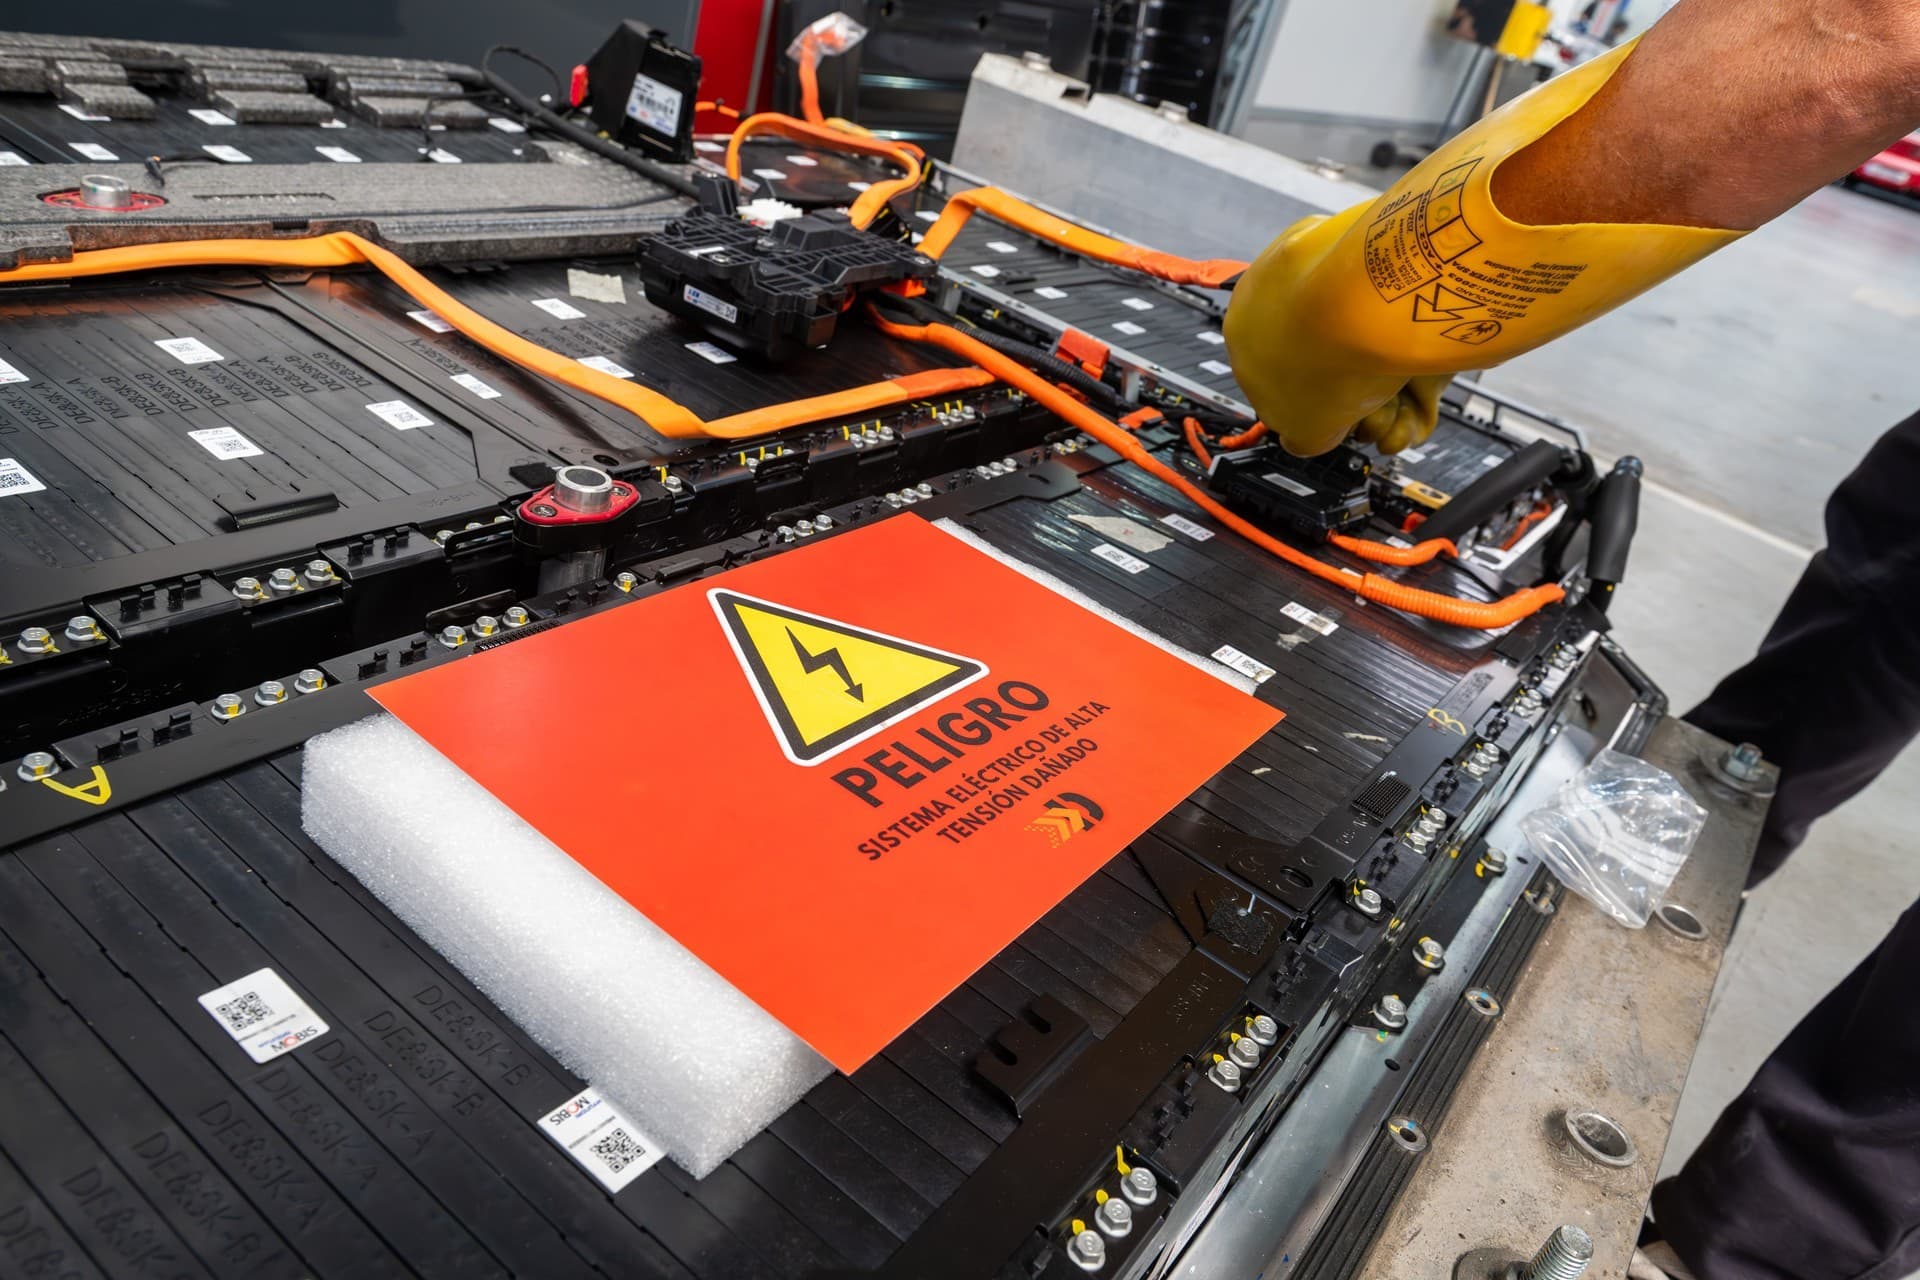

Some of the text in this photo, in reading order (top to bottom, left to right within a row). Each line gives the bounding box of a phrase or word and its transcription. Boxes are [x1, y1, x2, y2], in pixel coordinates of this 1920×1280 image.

[1373, 247, 1393, 290] TYRON
[1452, 260, 1471, 274] SPA
[1469, 271, 1512, 288] STARTER
[1455, 286, 1494, 303] POLAND
[1501, 301, 1529, 310] MADE
[831, 680, 1050, 809] PELIGRO
[42, 764, 112, 806] A
[858, 701, 1111, 861] SISTEMA ELÉCTRICO DE ALTA
[936, 738, 1098, 844] TENSIÓN DAÑADO
[270, 1026, 318, 1053] MOBIS
[414, 984, 530, 1089] DE&SK-B
[363, 1010, 485, 1118] DE&SK-B
[312, 1039, 436, 1159] DE&SK-A
[550, 1096, 591, 1126] MOBIS
